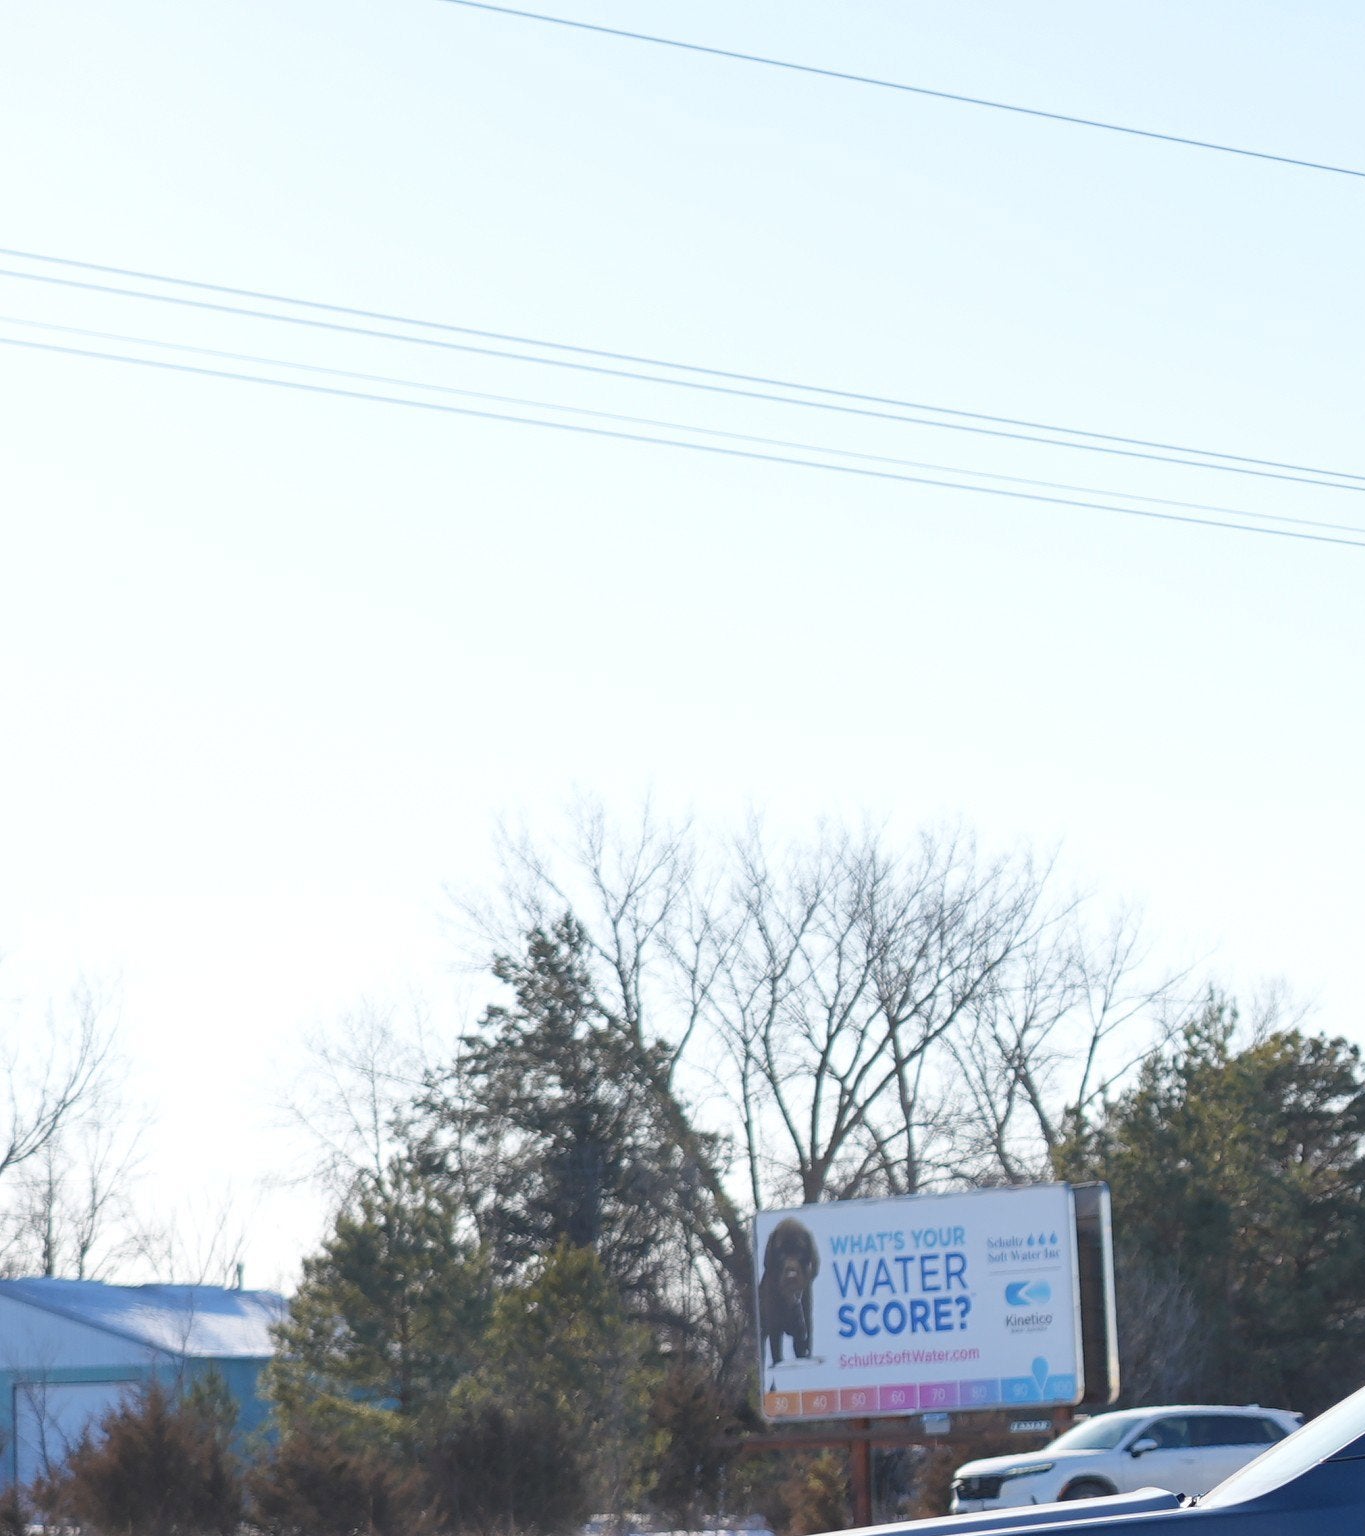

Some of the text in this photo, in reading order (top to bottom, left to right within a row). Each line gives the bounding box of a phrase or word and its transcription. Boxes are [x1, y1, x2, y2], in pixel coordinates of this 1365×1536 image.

[831, 1226, 965, 1256] WHAT'S YOUR
[986, 1235, 1023, 1249] Schultz
[1011, 1249, 1041, 1261] Water
[832, 1252, 968, 1298] WATER
[838, 1296, 972, 1338] SCORE?
[1006, 1313, 1053, 1328] Kinetico
[839, 1347, 980, 1370] SchultzSoftWater.com
[932, 1387, 946, 1401] 70
[1013, 1382, 1029, 1397] 90
